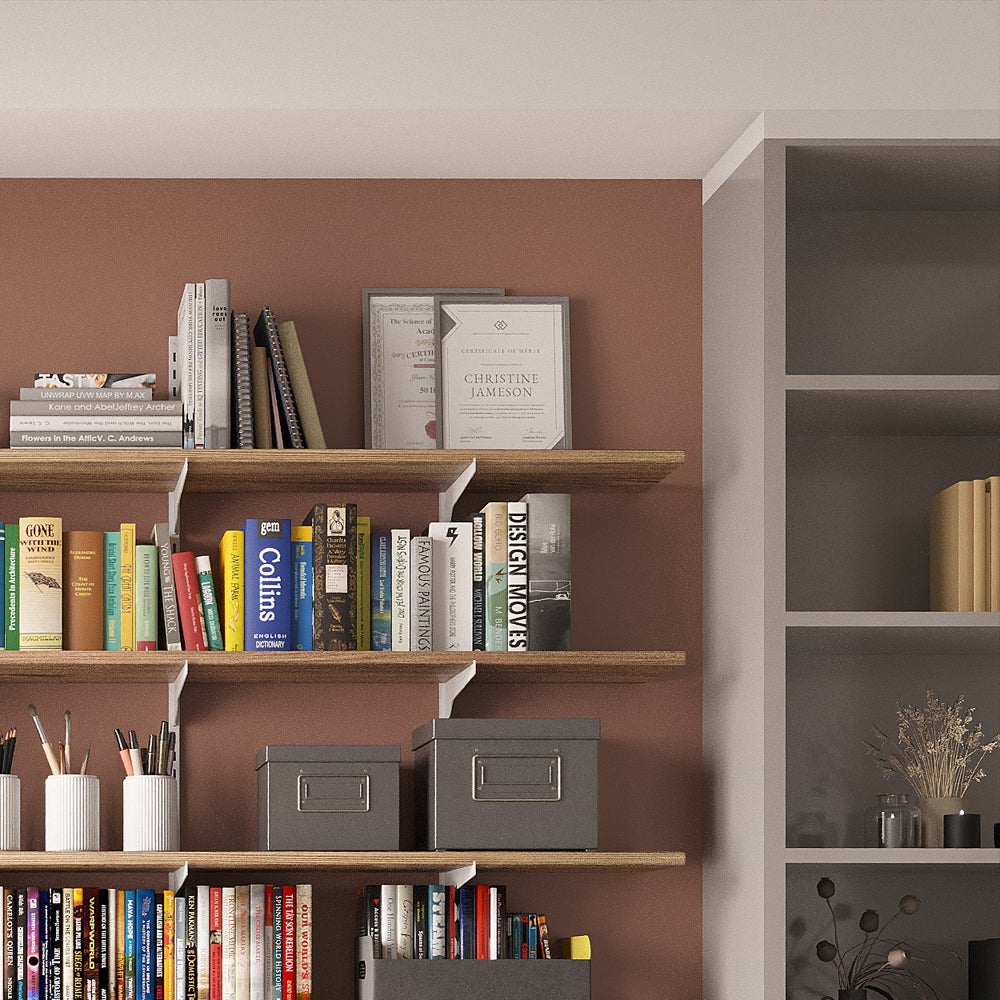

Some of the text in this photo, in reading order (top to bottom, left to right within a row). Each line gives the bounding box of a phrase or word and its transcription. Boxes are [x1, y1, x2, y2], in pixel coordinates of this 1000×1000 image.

[464, 373, 539, 384] CHRISTINE
[470, 387, 532, 400] JAMESON
[25, 524, 54, 538] GONE
[260, 521, 280, 536] gem
[473, 517, 483, 582] HOLLOW WORLD
[230, 554, 240, 580] ANIMAL
[160, 543, 177, 633] YOUNG THE SHACK
[258, 547, 282, 622] Collins
[509, 513, 527, 648] DESIGN MOVES
[201, 581, 214, 605] LAGOON
[418, 541, 431, 650] FAMOUS PAINTINGS
[495, 606, 503, 614] M
[255, 639, 285, 647] DICTIONARY
[495, 618, 503, 650] BENDER
[64, 915, 70, 923] ON
[432, 892, 445, 956] STEAM
[285, 894, 294, 972] THE REBELLION
[52, 947, 61, 966] TIME
[74, 950, 83, 972] SIEGE
[187, 954, 196, 992] DOMESTIC
[74, 977, 83, 999] ROME
